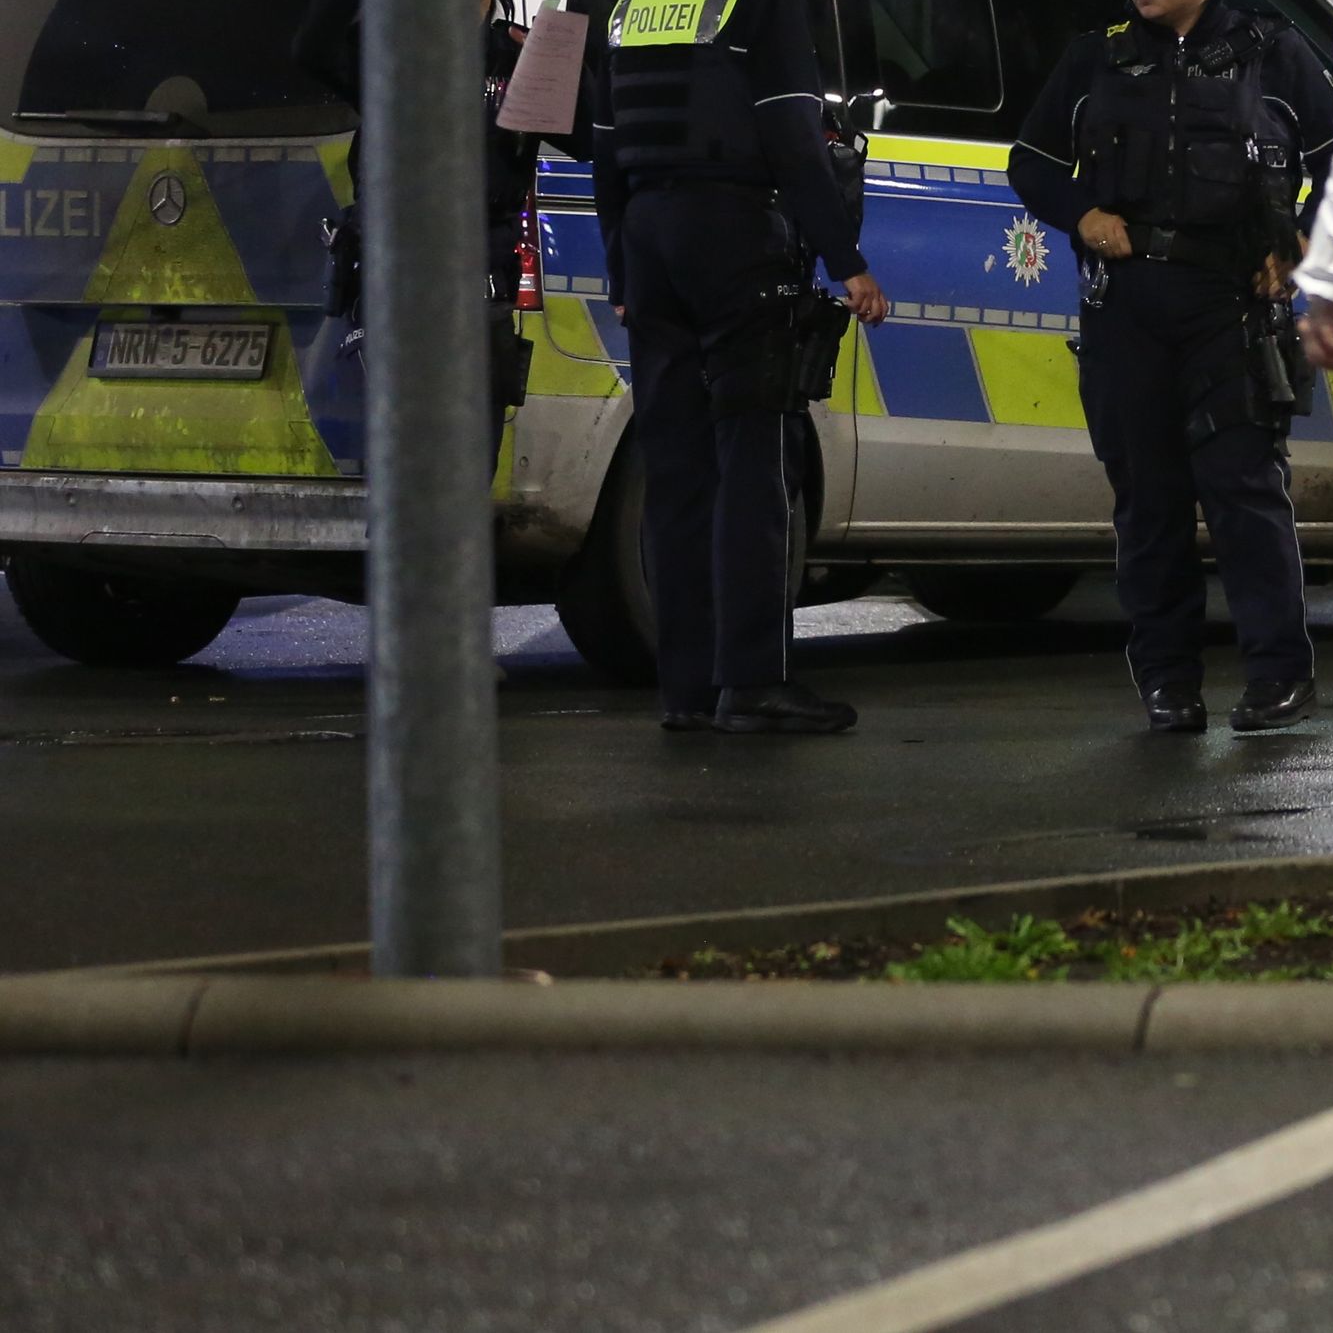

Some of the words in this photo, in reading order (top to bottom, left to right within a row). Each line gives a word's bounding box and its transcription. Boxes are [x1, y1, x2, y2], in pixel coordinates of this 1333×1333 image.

[626, 3, 697, 35] POLIZEI
[0, 189, 101, 237] LIZEI
[108, 328, 160, 365] NRW
